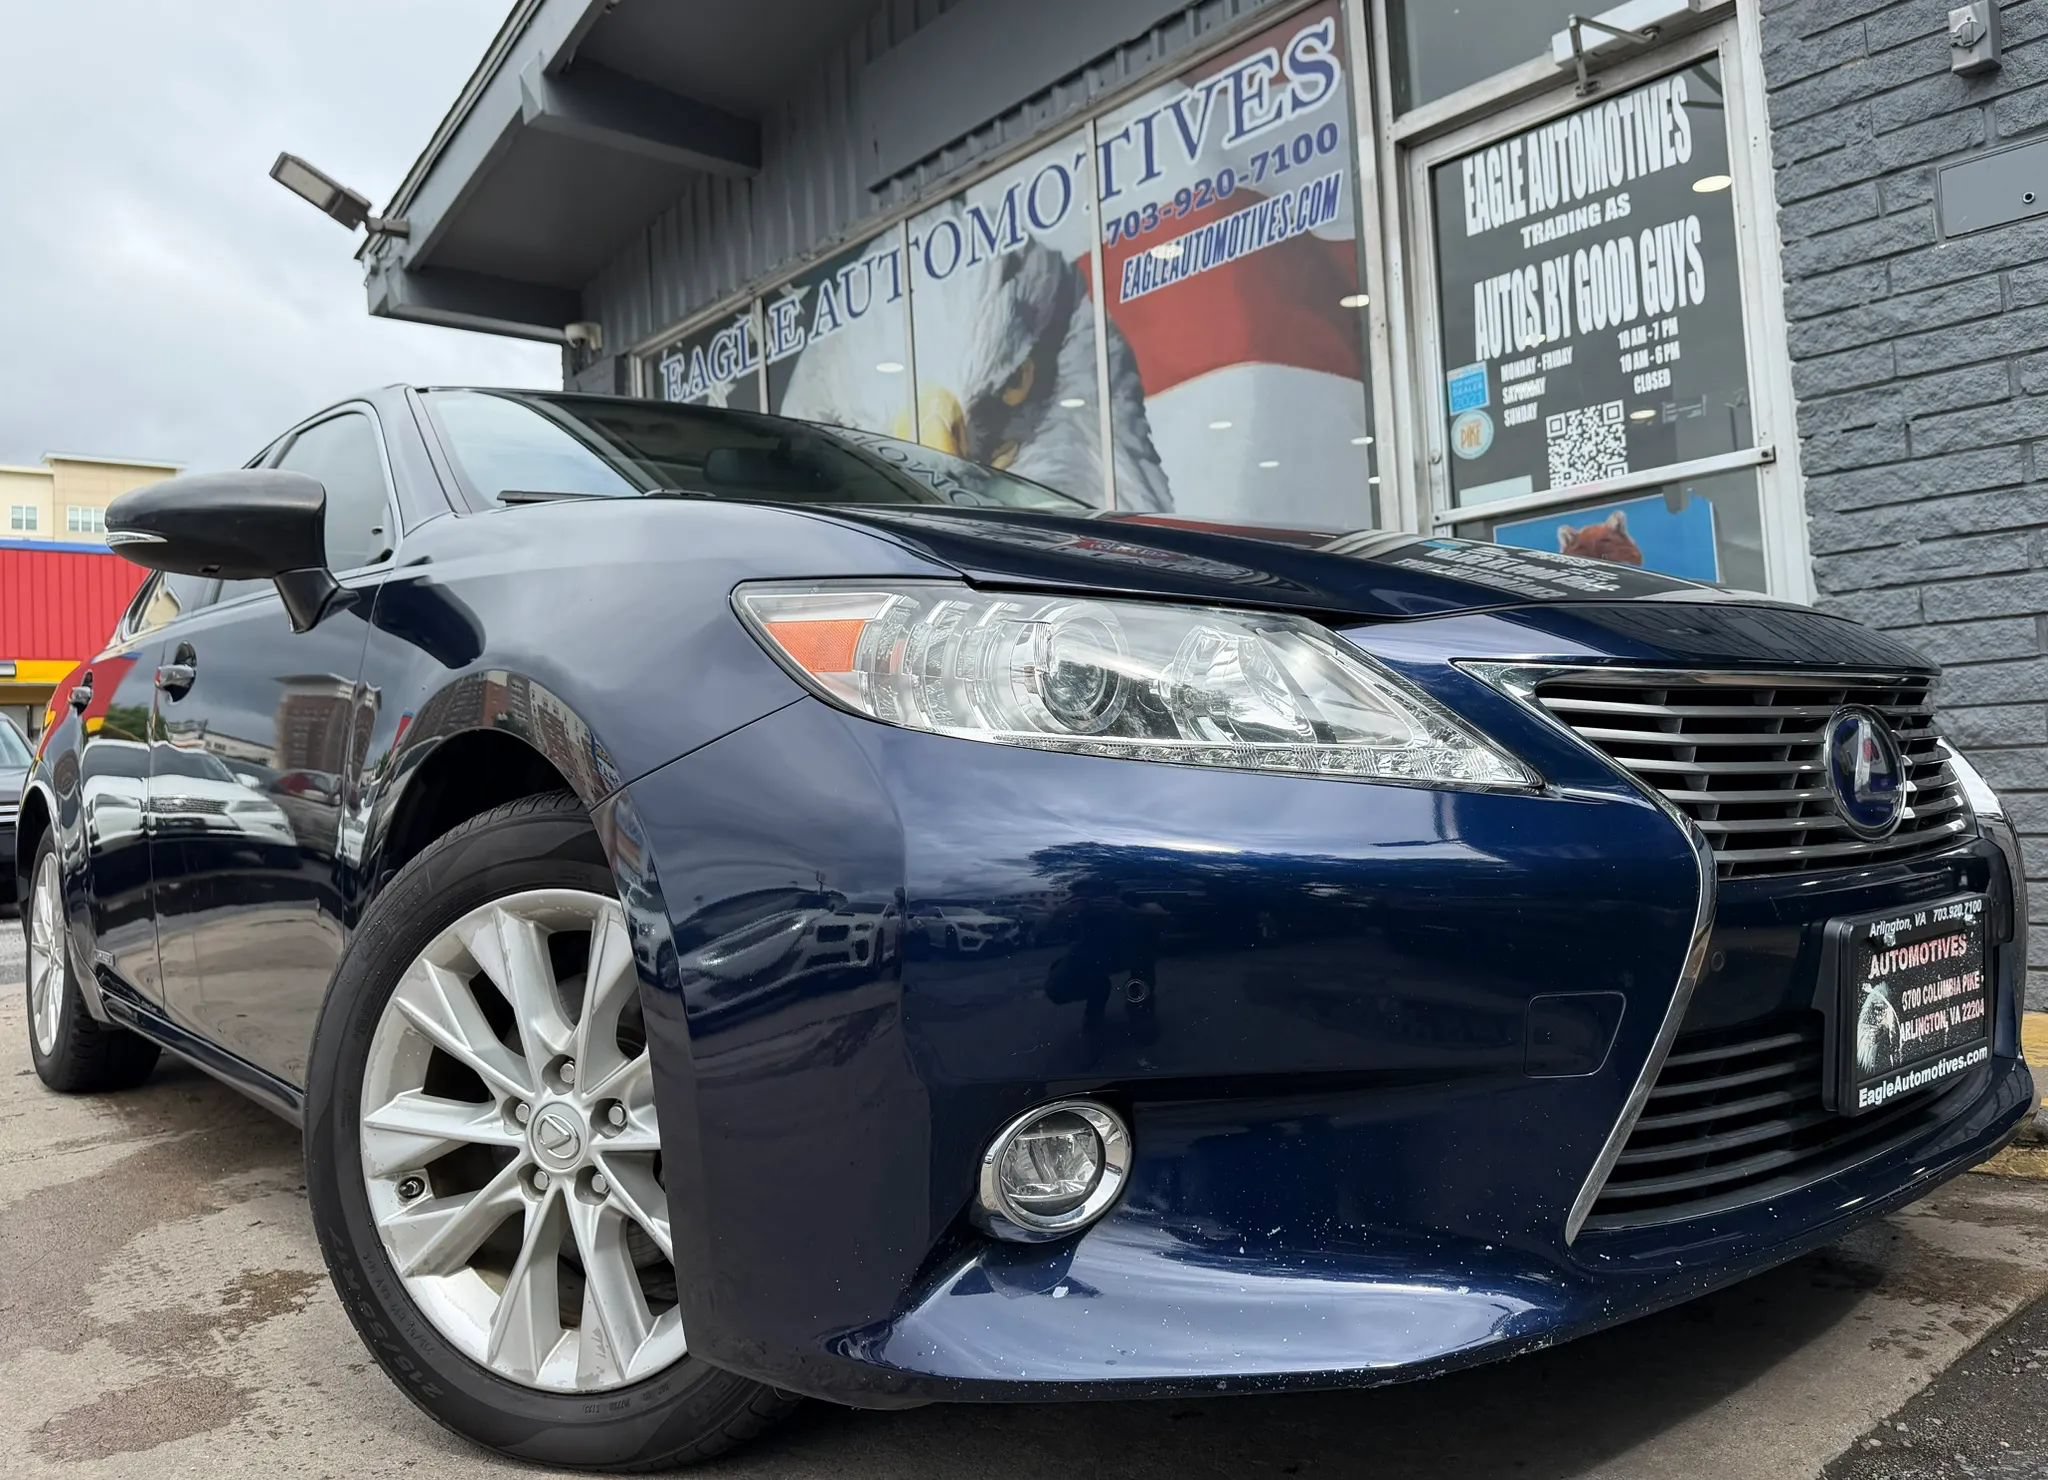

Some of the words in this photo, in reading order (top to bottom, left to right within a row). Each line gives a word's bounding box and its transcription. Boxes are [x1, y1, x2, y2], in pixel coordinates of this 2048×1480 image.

[1462, 138, 1527, 236] EAGLE
[1527, 75, 1692, 215] AUTOMOTIVES
[1106, 122, 1339, 247] 703-920-7100
[660, 294, 804, 403] EAGLE
[808, 17, 1341, 343] AUTOMOTIVES
[1520, 202, 1602, 249] TRADING
[1605, 192, 1632, 222] AS
[1120, 170, 1343, 303] EAGLEAUTOMOTIVES.COM
[1474, 264, 1542, 361] AUTOS
[1541, 254, 1571, 342] BY
[1574, 236, 1639, 335] GOOD
[1639, 214, 1706, 317] GUYS
[1617, 330, 1630, 350] 10
[1631, 325, 1647, 346] AM
[1662, 316, 1679, 336] PM
[1500, 355, 1537, 383] MONDAY
[1541, 346, 1573, 371] FRIDAY
[1620, 353, 1632, 373] 10
[1633, 349, 1650, 370] AM
[1665, 341, 1681, 362] PM
[1634, 368, 1671, 394] CLOSED
[1503, 402, 1538, 427] SUNDAY
[1869, 915, 1912, 939] Arlington,
[1914, 914, 1926, 928] VA
[1933, 900, 1982, 922] 703.920.7100
[1868, 933, 1968, 980] AUTOMOTIVES
[1922, 977, 1962, 1003] COLUMBIA
[1962, 970, 1980, 991] PIKE
[1949, 1008, 1961, 1026] VA
[1962, 998, 1985, 1022] 22204
[1858, 1046, 1988, 1108] EagleAutomotives.com
